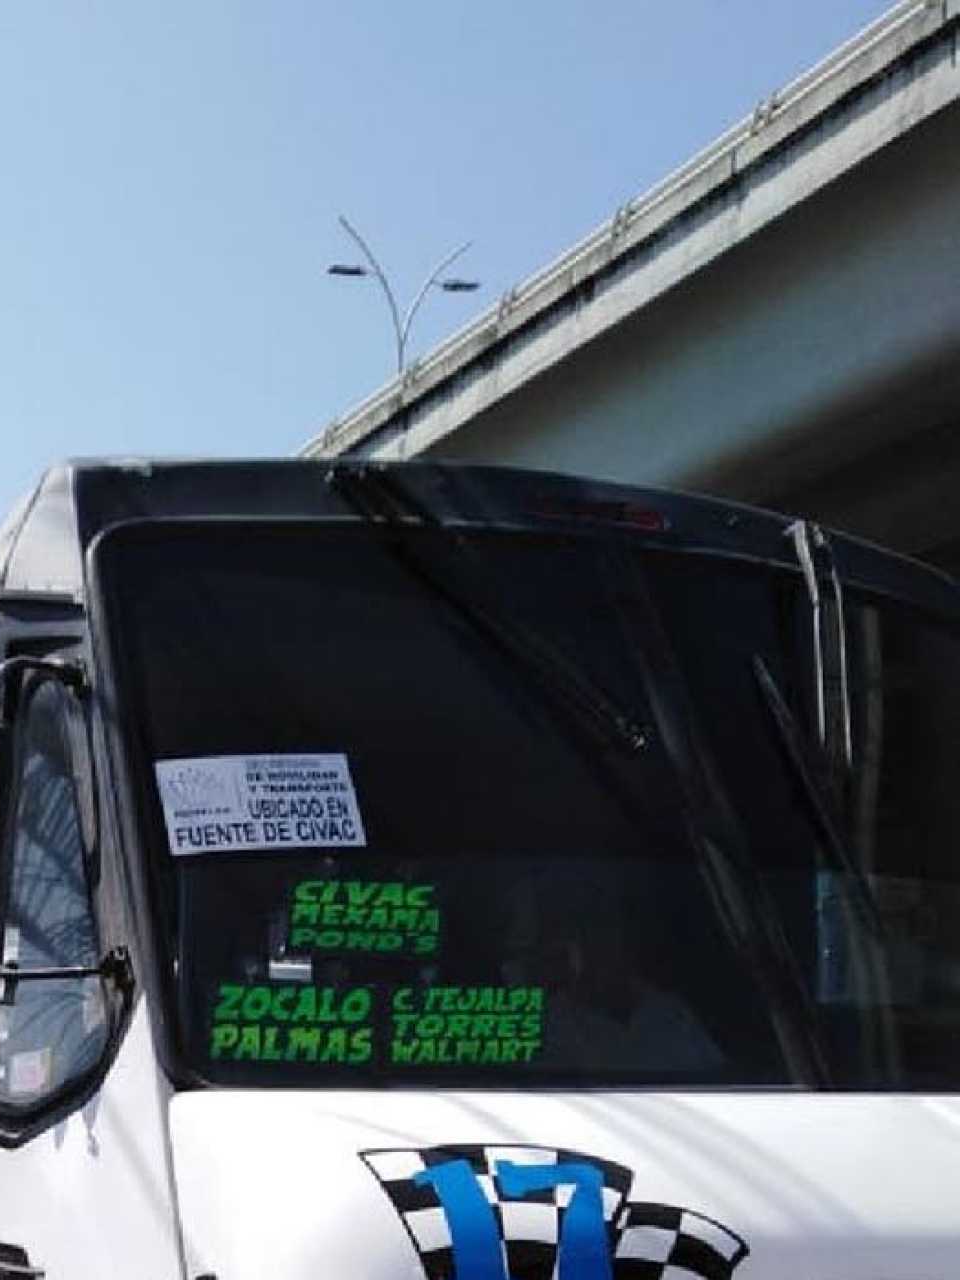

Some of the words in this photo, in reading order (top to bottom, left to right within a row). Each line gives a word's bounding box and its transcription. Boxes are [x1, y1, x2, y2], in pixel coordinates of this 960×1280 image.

[247, 797, 324, 820] UBICADO
[327, 797, 349, 817] EN
[174, 822, 257, 847] FUENTE
[263, 821, 291, 842] DE
[296, 819, 356, 841] CIVAC
[295, 880, 434, 907] CIVAC
[213, 986, 371, 1022] ZOCALO
[392, 1014, 542, 1038] TORRES
[211, 1025, 373, 1060] PALMAS
[392, 1038, 542, 1064] WALMART
